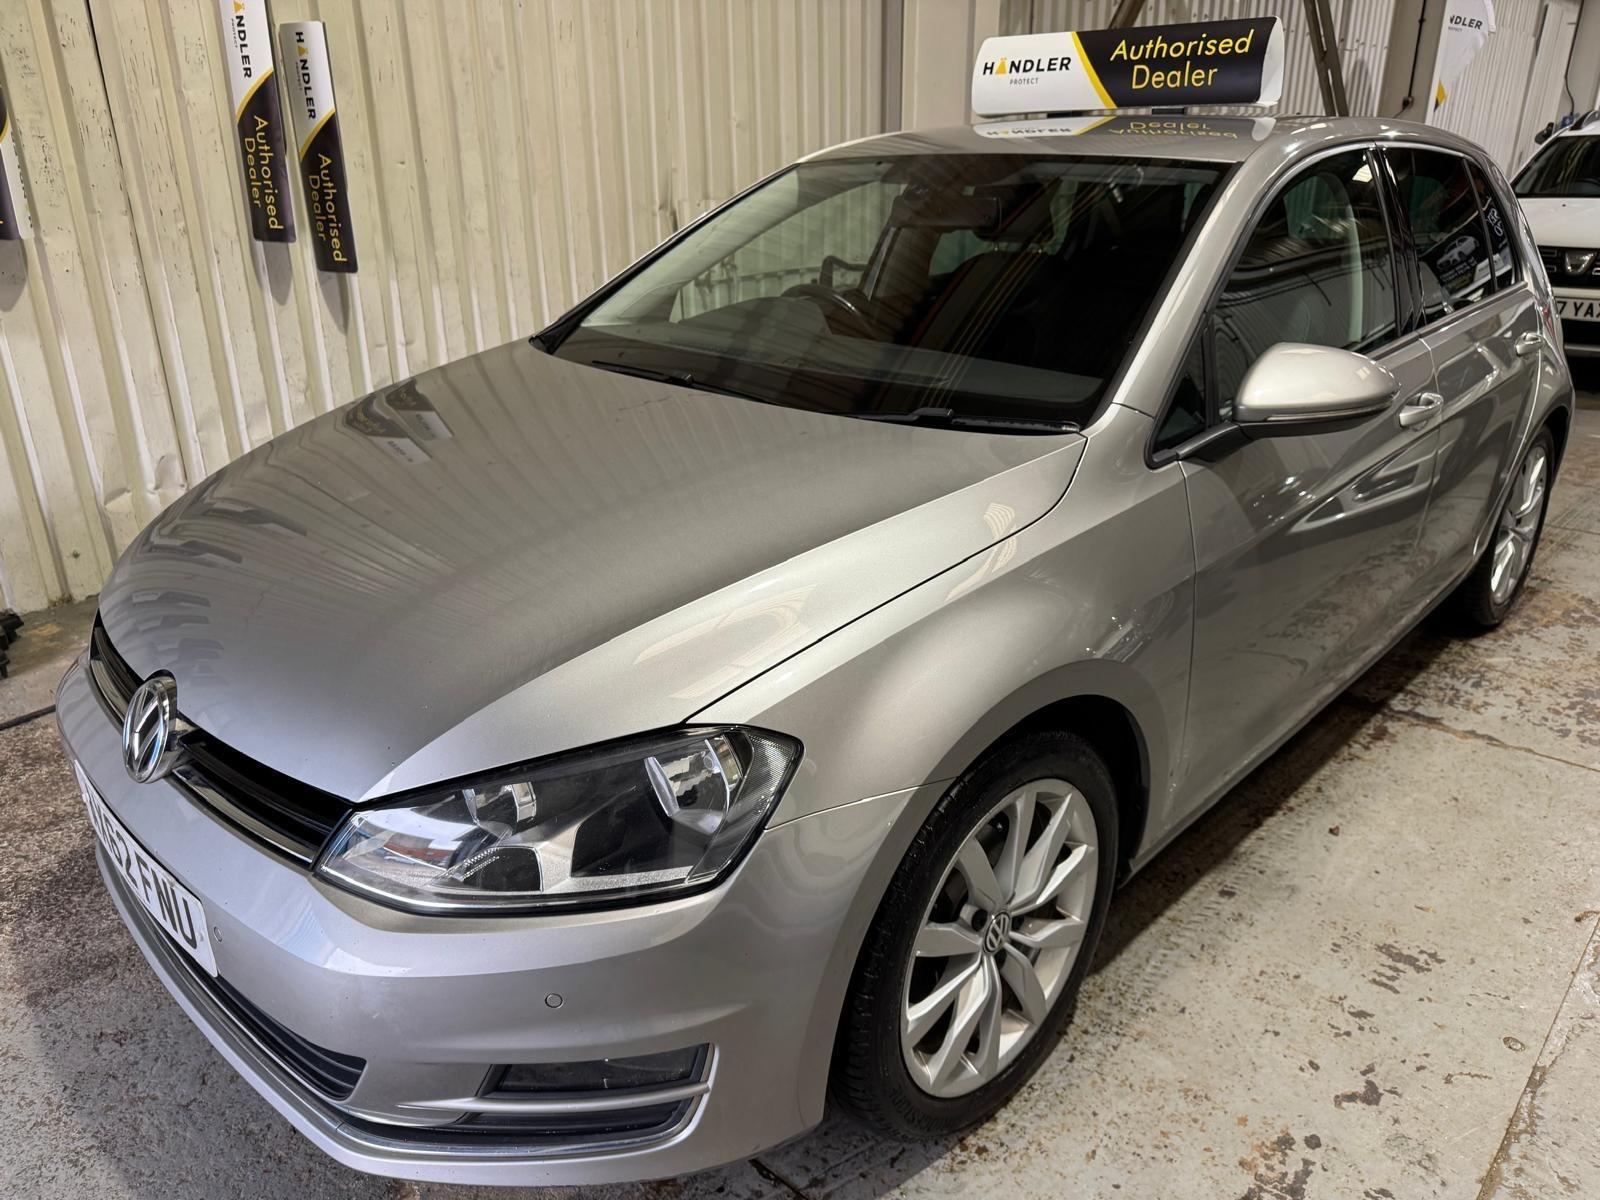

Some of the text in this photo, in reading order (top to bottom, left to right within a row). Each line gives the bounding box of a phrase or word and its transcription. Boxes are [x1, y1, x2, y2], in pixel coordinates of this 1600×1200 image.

[1110, 29, 1255, 61] Authorised
[1132, 61, 1218, 89] Dealer
[1009, 77, 1039, 86] PROTECT
[244, 137, 262, 209] Dealer
[254, 115, 284, 230] Authorised
[318, 153, 347, 261] Authorised
[308, 175, 326, 242] Dealer
[135, 852, 198, 950] FNU
